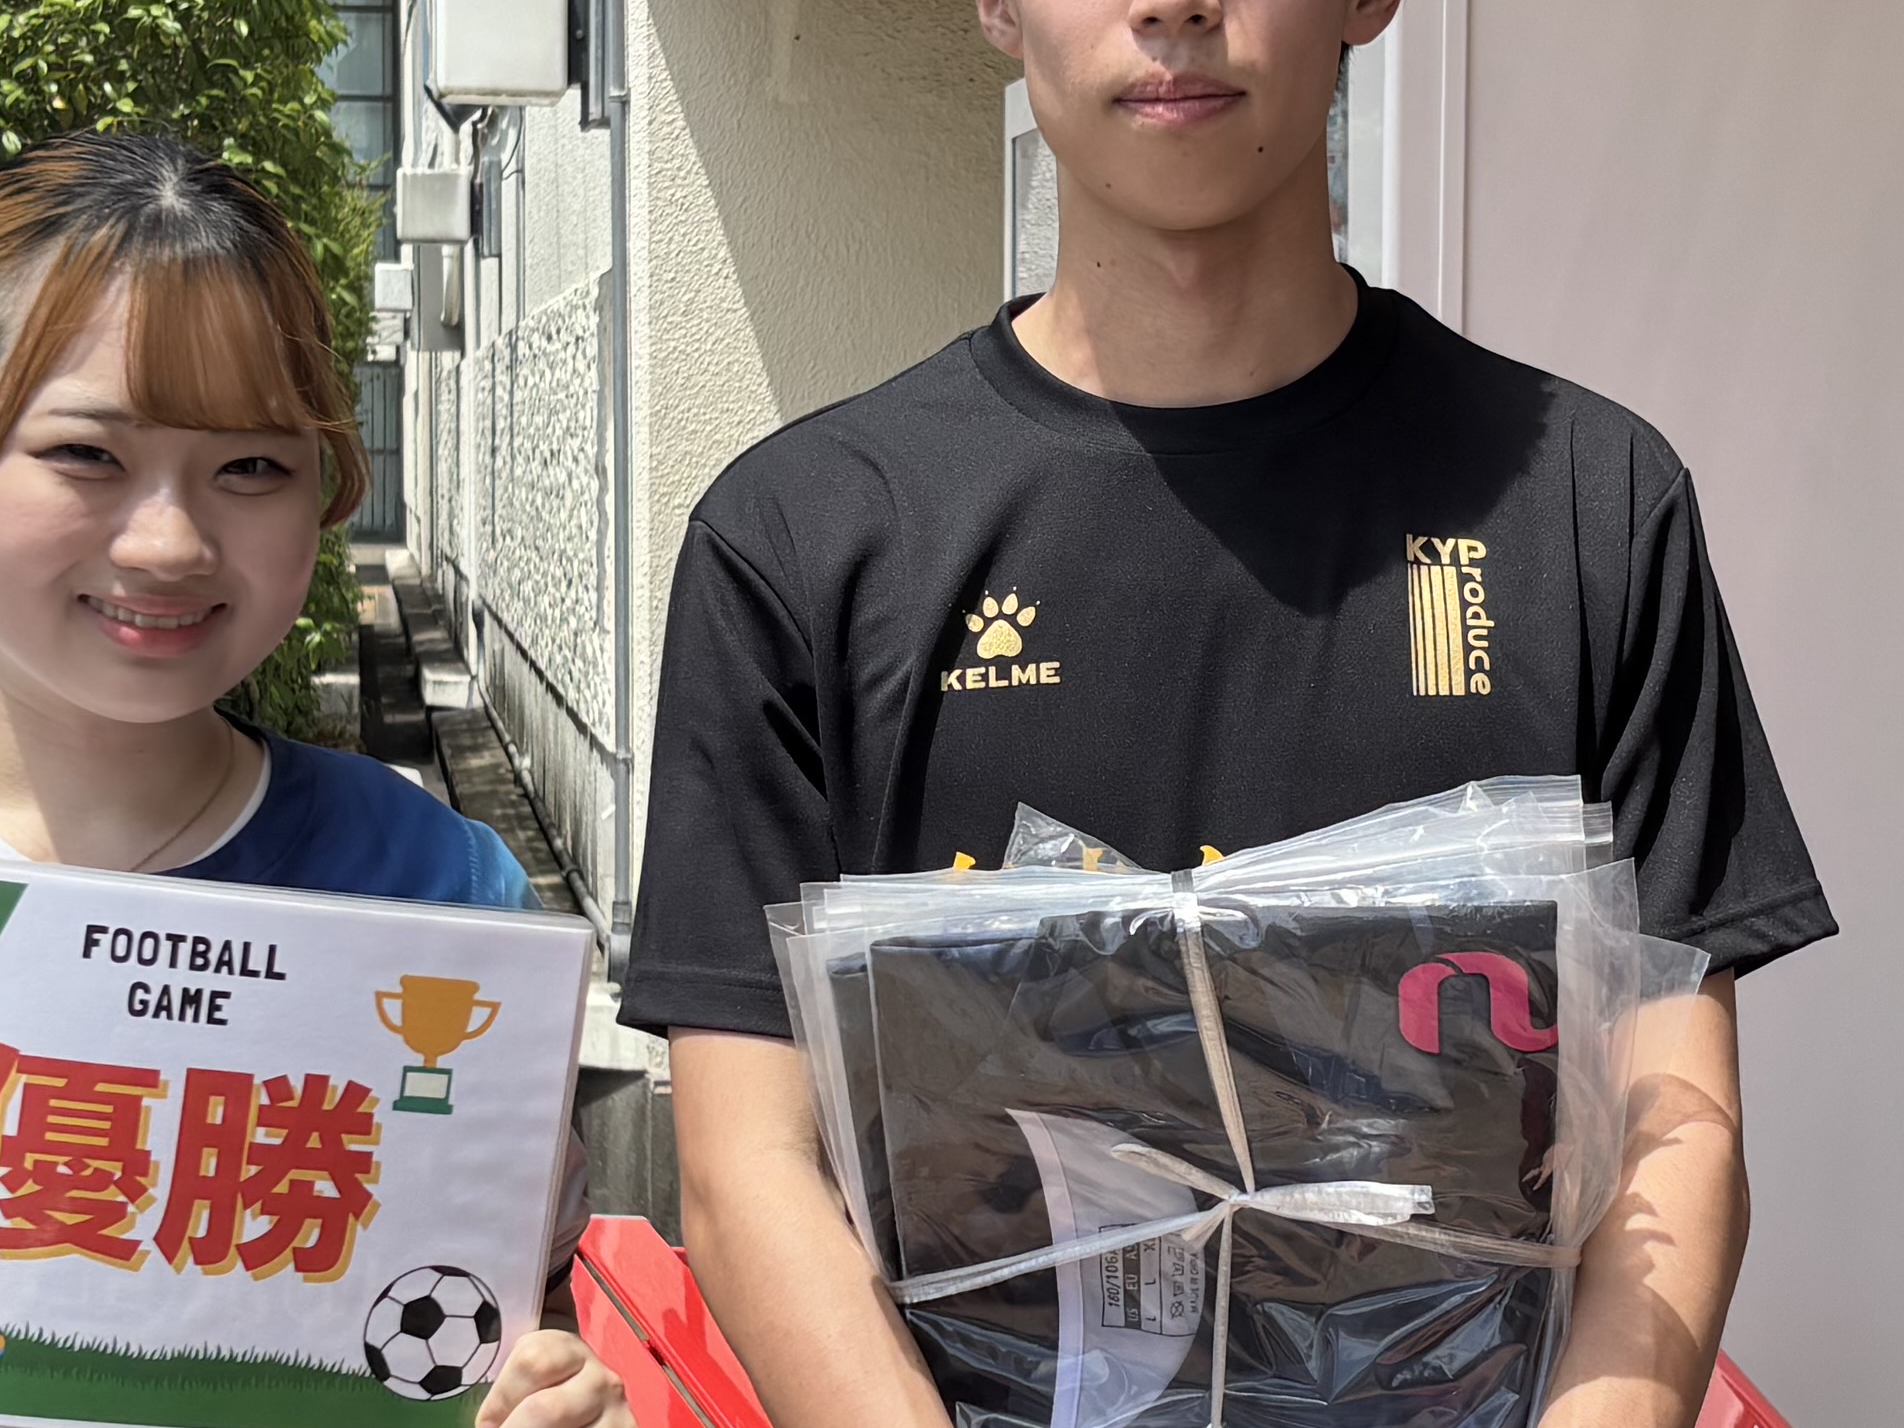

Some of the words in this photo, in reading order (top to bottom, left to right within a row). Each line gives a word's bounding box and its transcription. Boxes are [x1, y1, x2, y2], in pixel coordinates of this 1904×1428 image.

[940, 661, 1061, 692] KELME
[82, 924, 287, 981] FOOTBALL
[127, 981, 233, 1026] GAME
[1126, 1273, 1138, 1291] EU
